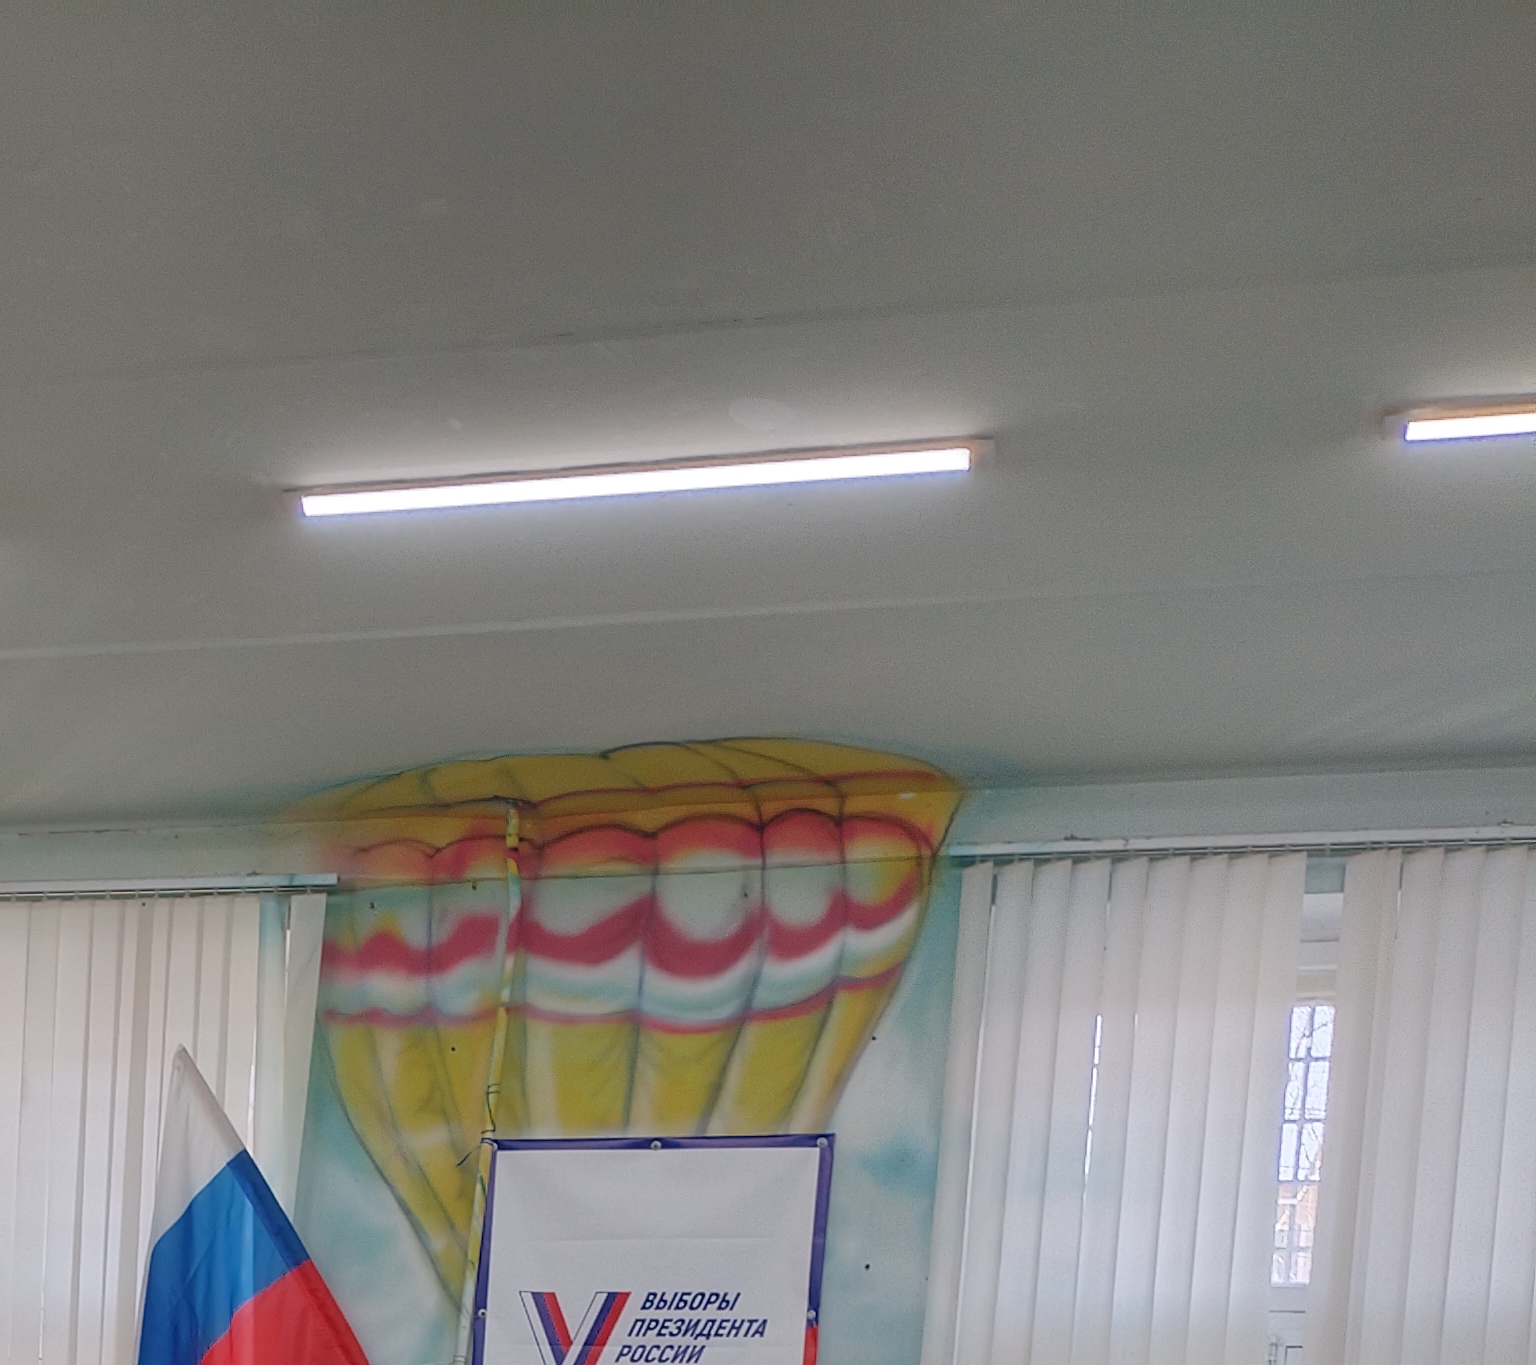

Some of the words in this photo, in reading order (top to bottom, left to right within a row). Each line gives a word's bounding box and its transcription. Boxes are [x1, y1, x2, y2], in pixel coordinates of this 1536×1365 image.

[640, 1292, 742, 1311] ВЫБОРЫ
[627, 1318, 768, 1340] ПРЕЗИДЕНТА
[614, 1345, 706, 1363] РОССИИ
